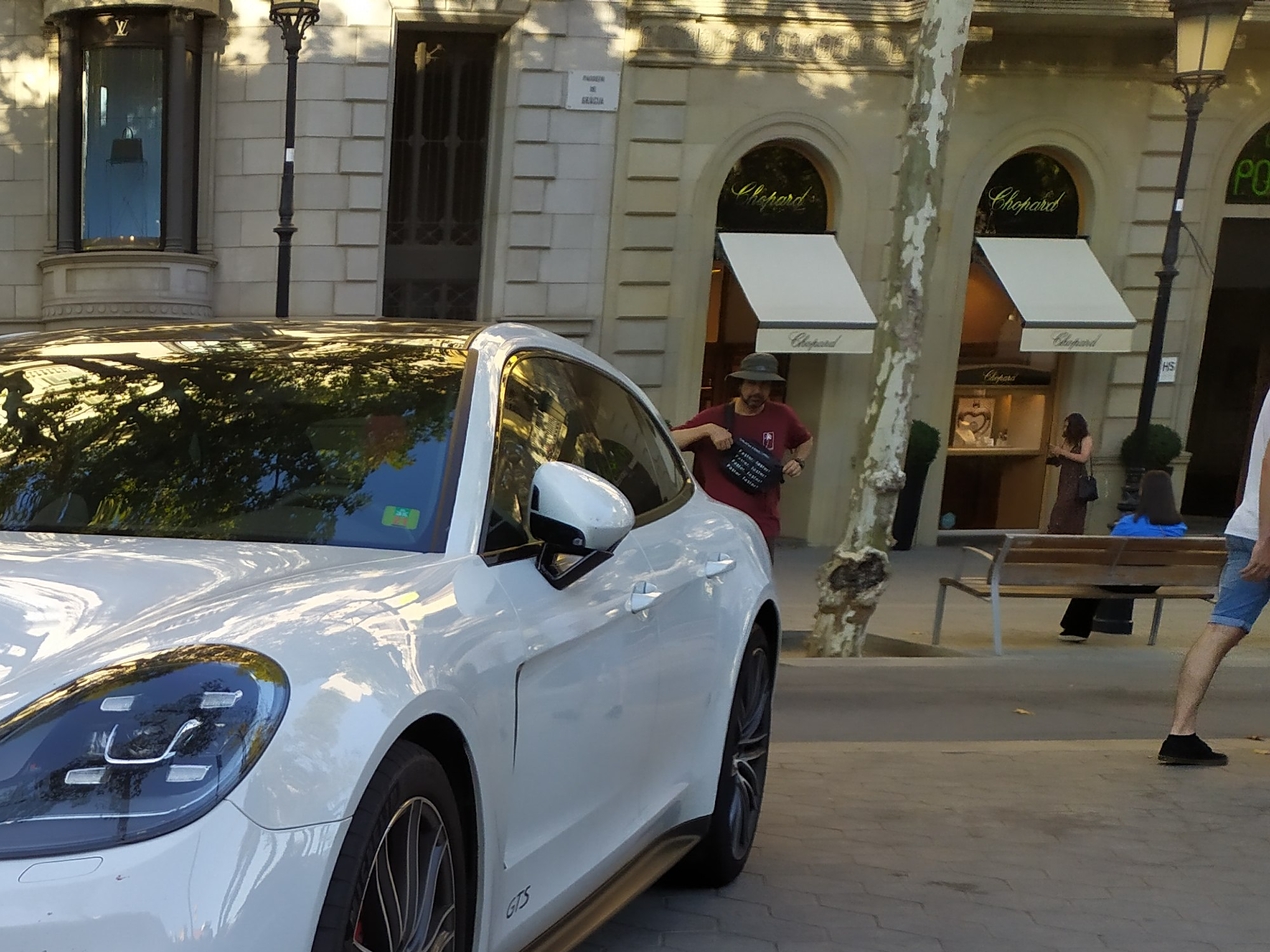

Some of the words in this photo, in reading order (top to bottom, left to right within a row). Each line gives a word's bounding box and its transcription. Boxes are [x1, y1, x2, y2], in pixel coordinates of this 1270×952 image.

[731, 181, 813, 212] Chopard
[988, 186, 1066, 216] Chopard
[788, 331, 843, 351] Chopard
[1052, 331, 1103, 350] Chopard
[983, 369, 1020, 384] Chopard
[506, 885, 531, 919] GTS
